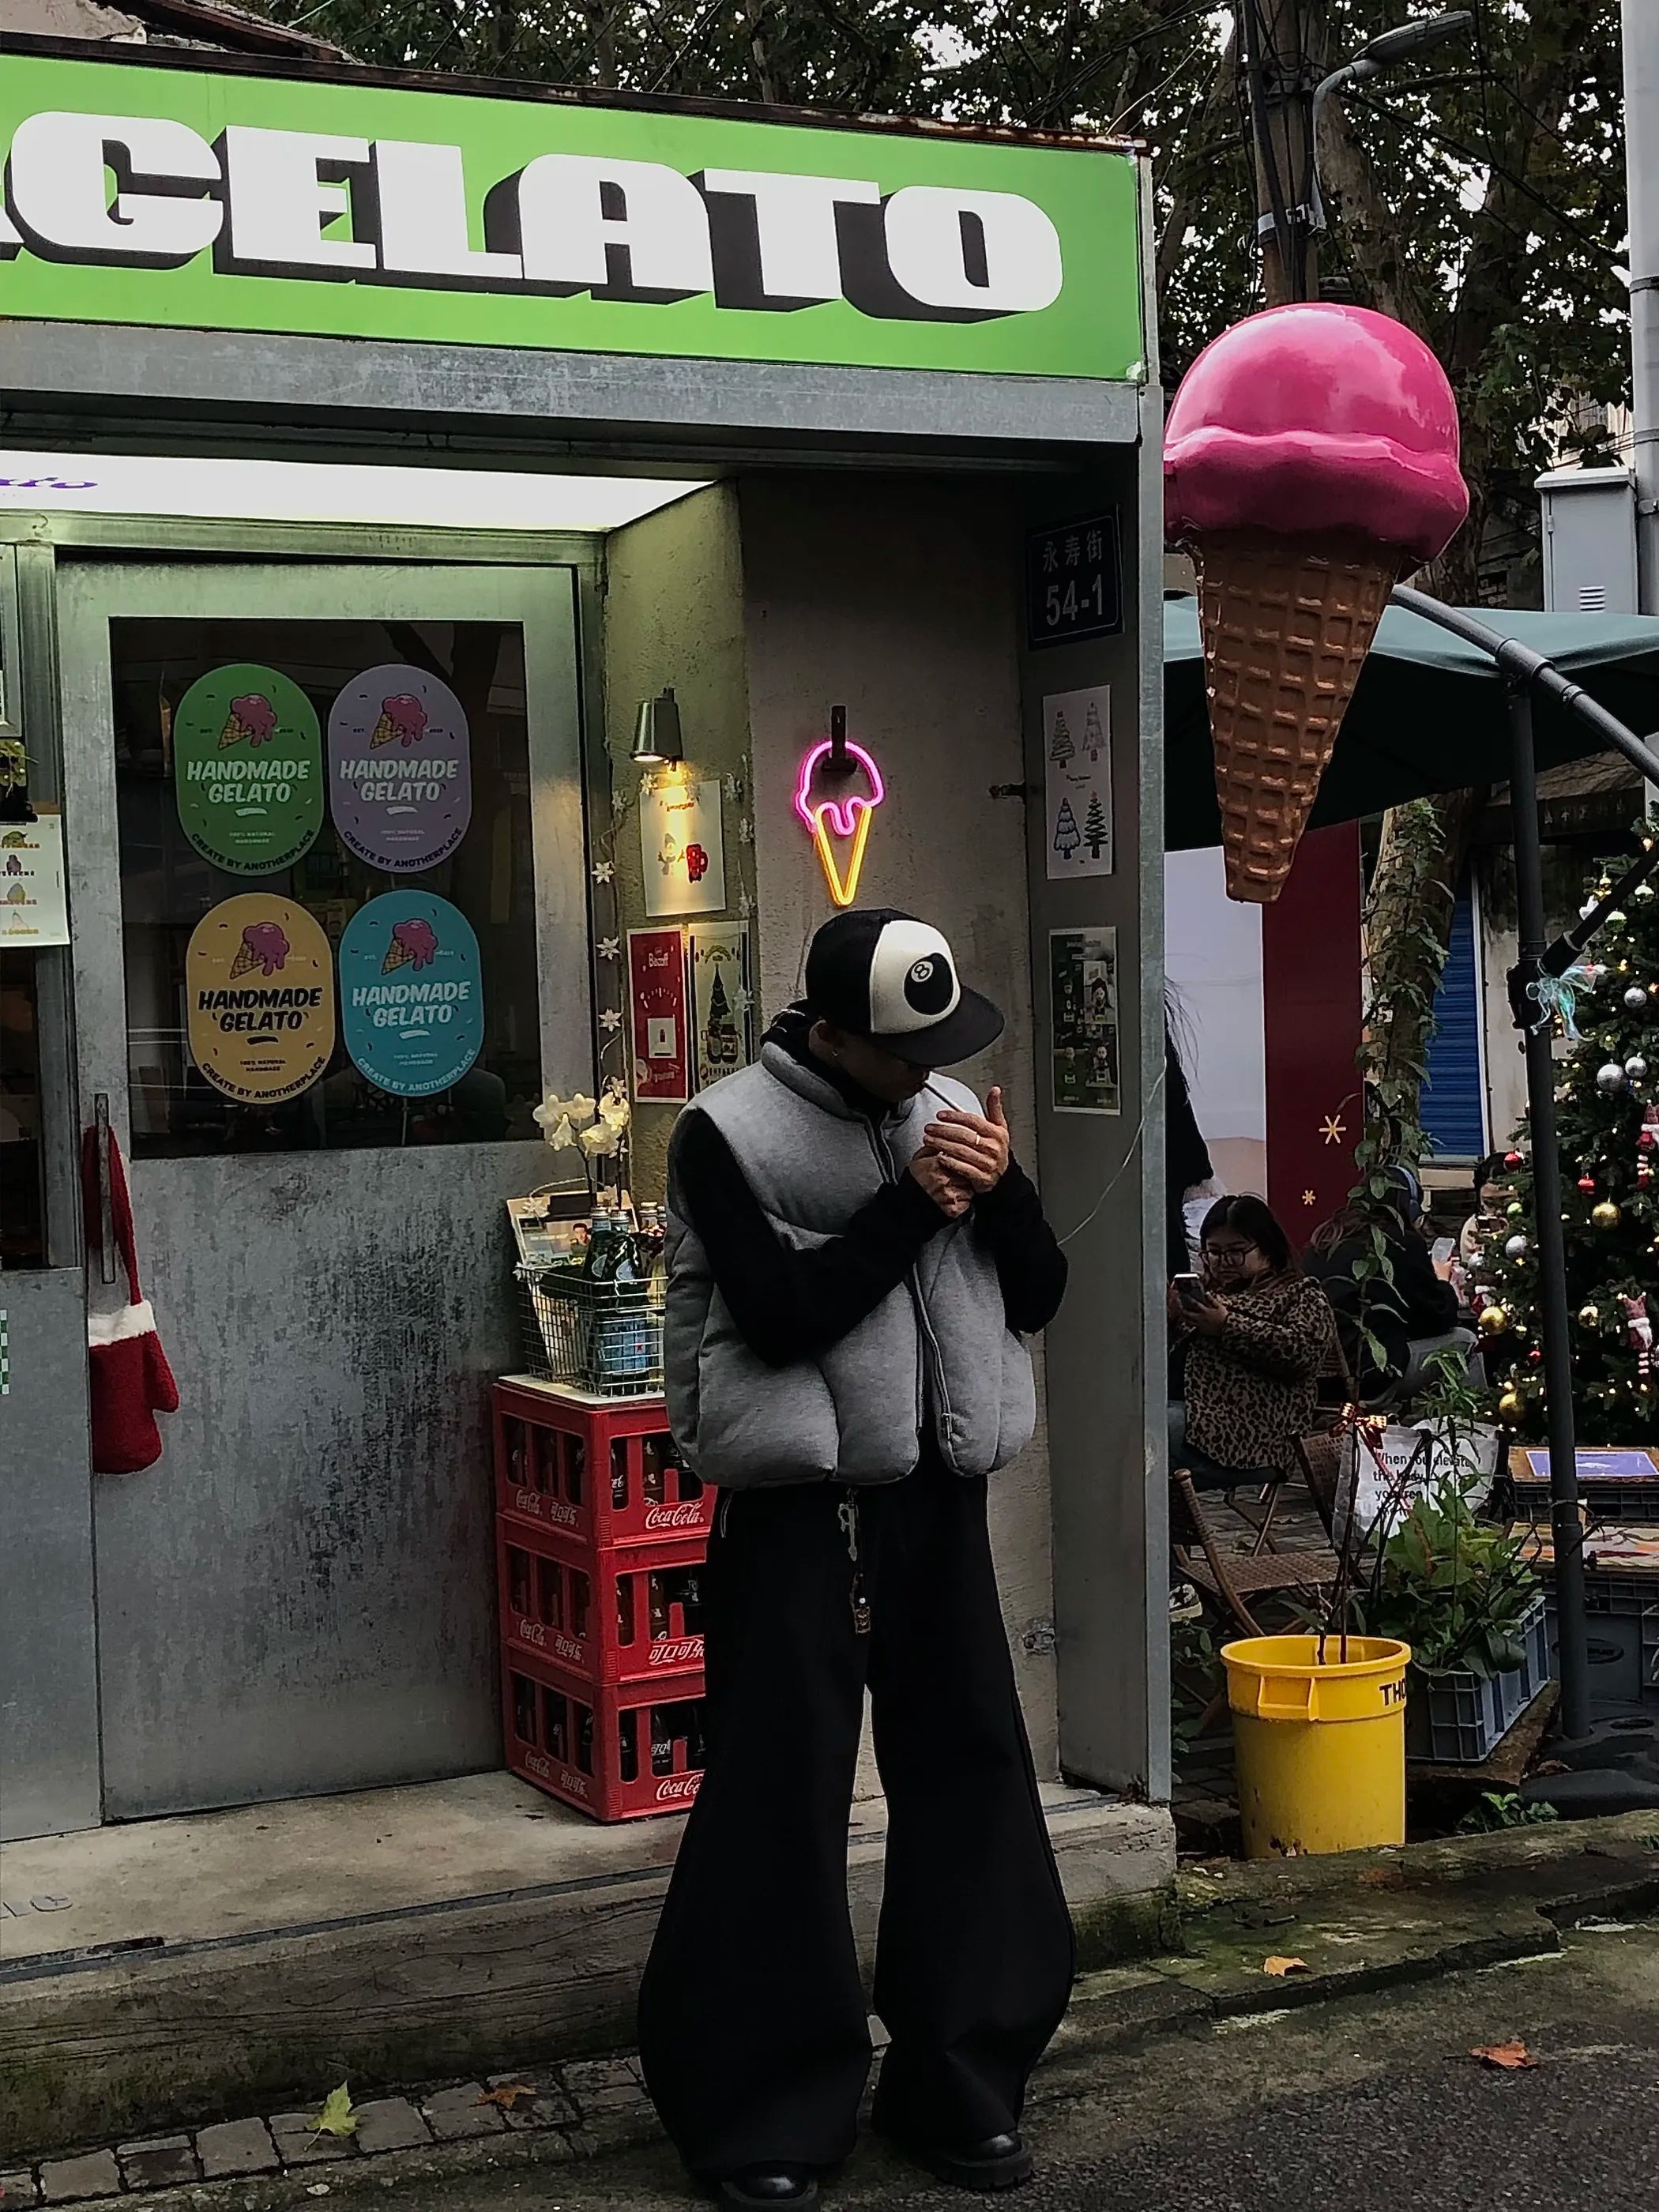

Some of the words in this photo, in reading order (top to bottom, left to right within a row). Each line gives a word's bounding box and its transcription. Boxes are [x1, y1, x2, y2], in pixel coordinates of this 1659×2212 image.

[0, 111, 1064, 318] GELATO
[1043, 530, 1103, 573] 永寿街
[1046, 574, 1103, 626] 54-1
[186, 760, 311, 781] HANDMADE
[340, 759, 460, 780] HANDMADE
[208, 782, 292, 803] GELATO
[360, 781, 441, 801] GELATO
[191, 833, 225, 863] CREATE
[227, 857, 241, 869] BY
[243, 828, 315, 871] ANOTHERPLACE
[343, 830, 377, 860] CREATE
[378, 855, 392, 867] BY
[393, 826, 463, 868] ANOTHERPLACE
[914, 963, 930, 980] 8
[198, 987, 323, 1010] HANDMADE
[352, 980, 472, 1006] HANDMADE
[219, 1010, 303, 1032] GELATO
[373, 1004, 453, 1028] GELATO
[202, 1063, 235, 1093] CREATE
[237, 1086, 252, 1097] BY
[254, 1055, 325, 1099] ANOTHERPLACE
[356, 1057, 390, 1086] CREATE
[392, 1080, 406, 1091] BY
[408, 1048, 476, 1092] ANOTHERPLACE
[649, 1638, 705, 1666] 可口可乐
[656, 1774, 704, 1801] Coca-Co
